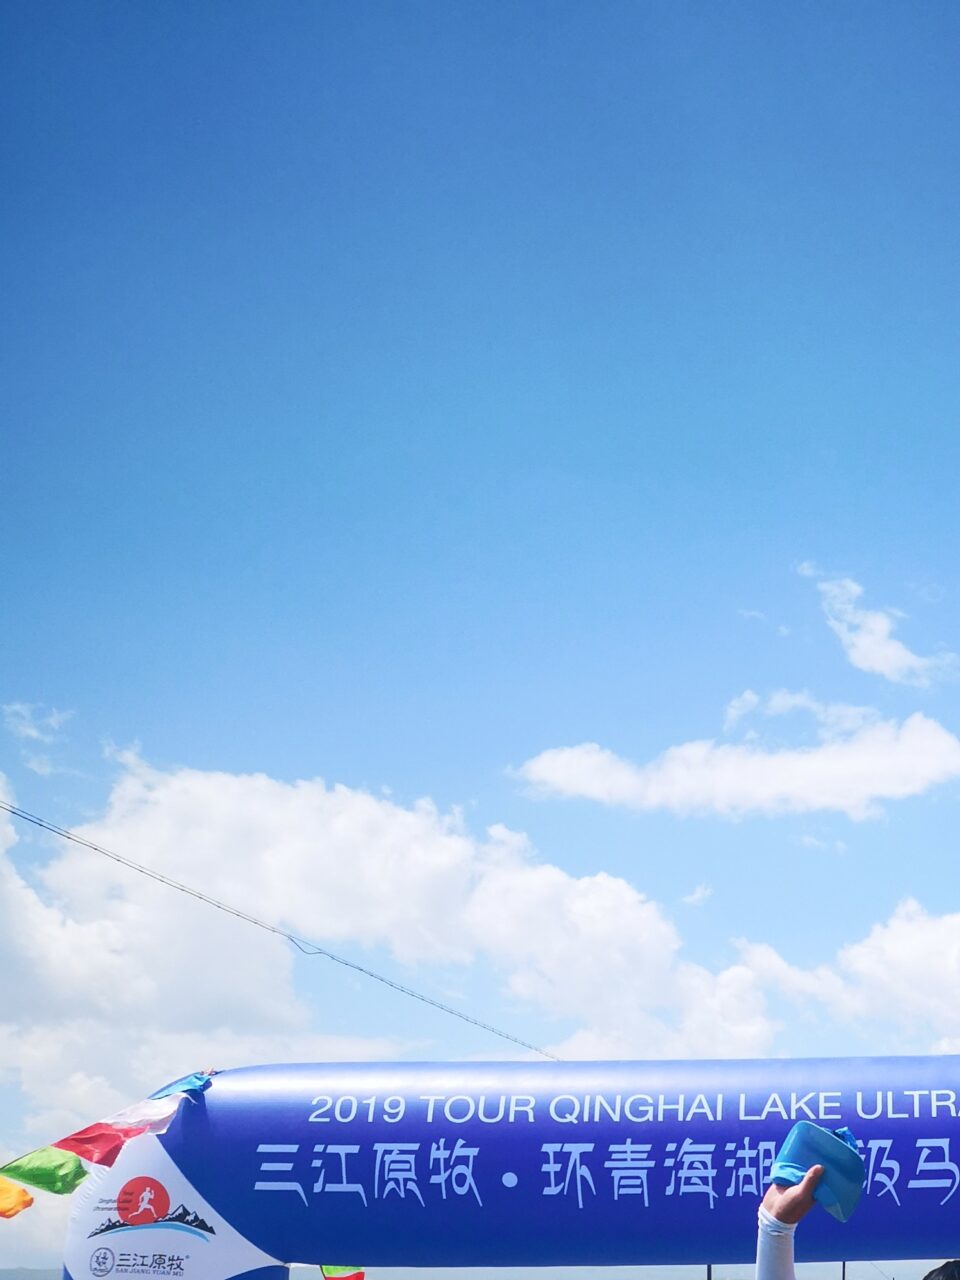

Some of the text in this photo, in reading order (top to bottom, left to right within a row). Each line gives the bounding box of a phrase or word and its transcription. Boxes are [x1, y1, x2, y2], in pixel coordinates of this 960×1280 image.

[308, 1094, 405, 1124] 2019
[427, 1094, 536, 1123] TOUR
[550, 1093, 723, 1124] QINGHAI
[739, 1091, 842, 1122] LAKE
[116, 1253, 184, 1271] 三江原牧
